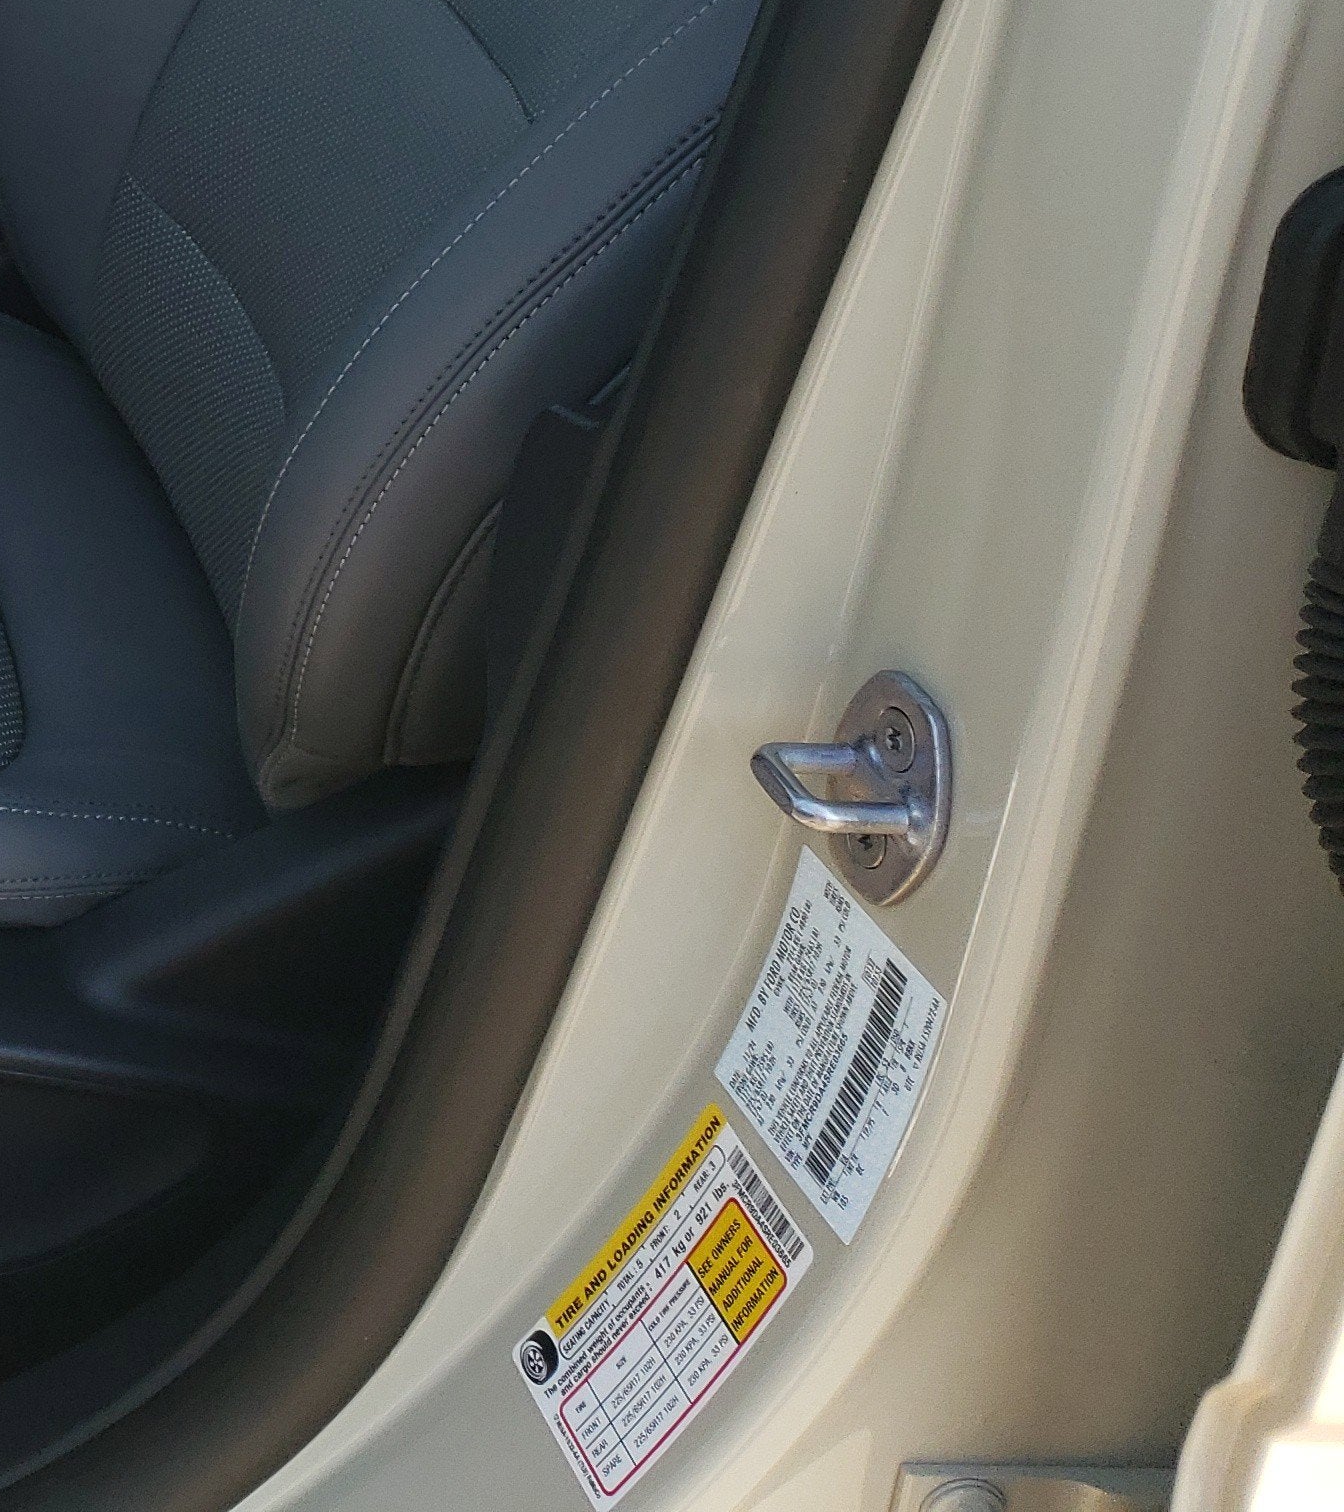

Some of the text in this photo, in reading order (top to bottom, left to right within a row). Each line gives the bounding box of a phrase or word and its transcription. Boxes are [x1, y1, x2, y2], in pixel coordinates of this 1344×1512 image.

[757, 986, 769, 1005] BY
[763, 959, 780, 990] FORD
[775, 922, 795, 963] MOTOR
[554, 1115, 720, 1328] TIRE AND LOADING INFORMATION
[562, 1326, 585, 1353] SEATING
[584, 1298, 609, 1330] CAPACITY
[673, 1209, 681, 1220] 2
[708, 1160, 715, 1171] 3
[654, 1182, 729, 1278] 417 kg or 921 lbs.
[697, 1218, 740, 1278] SEE OWNERS
[708, 1235, 753, 1296] MANUAL FOR
[722, 1256, 764, 1312] ADDITIONAL
[730, 1266, 778, 1332] INFORMATION
[543, 1284, 645, 1398] The combined weight of occupants
[560, 1291, 650, 1396] and cargo should never exceed
[581, 1416, 600, 1439] FRONT
[663, 1332, 675, 1348] 230
[591, 1438, 608, 1458] REAR
[674, 1349, 686, 1365] 230
[601, 1454, 622, 1477] SPARE
[687, 1370, 699, 1386] 230
